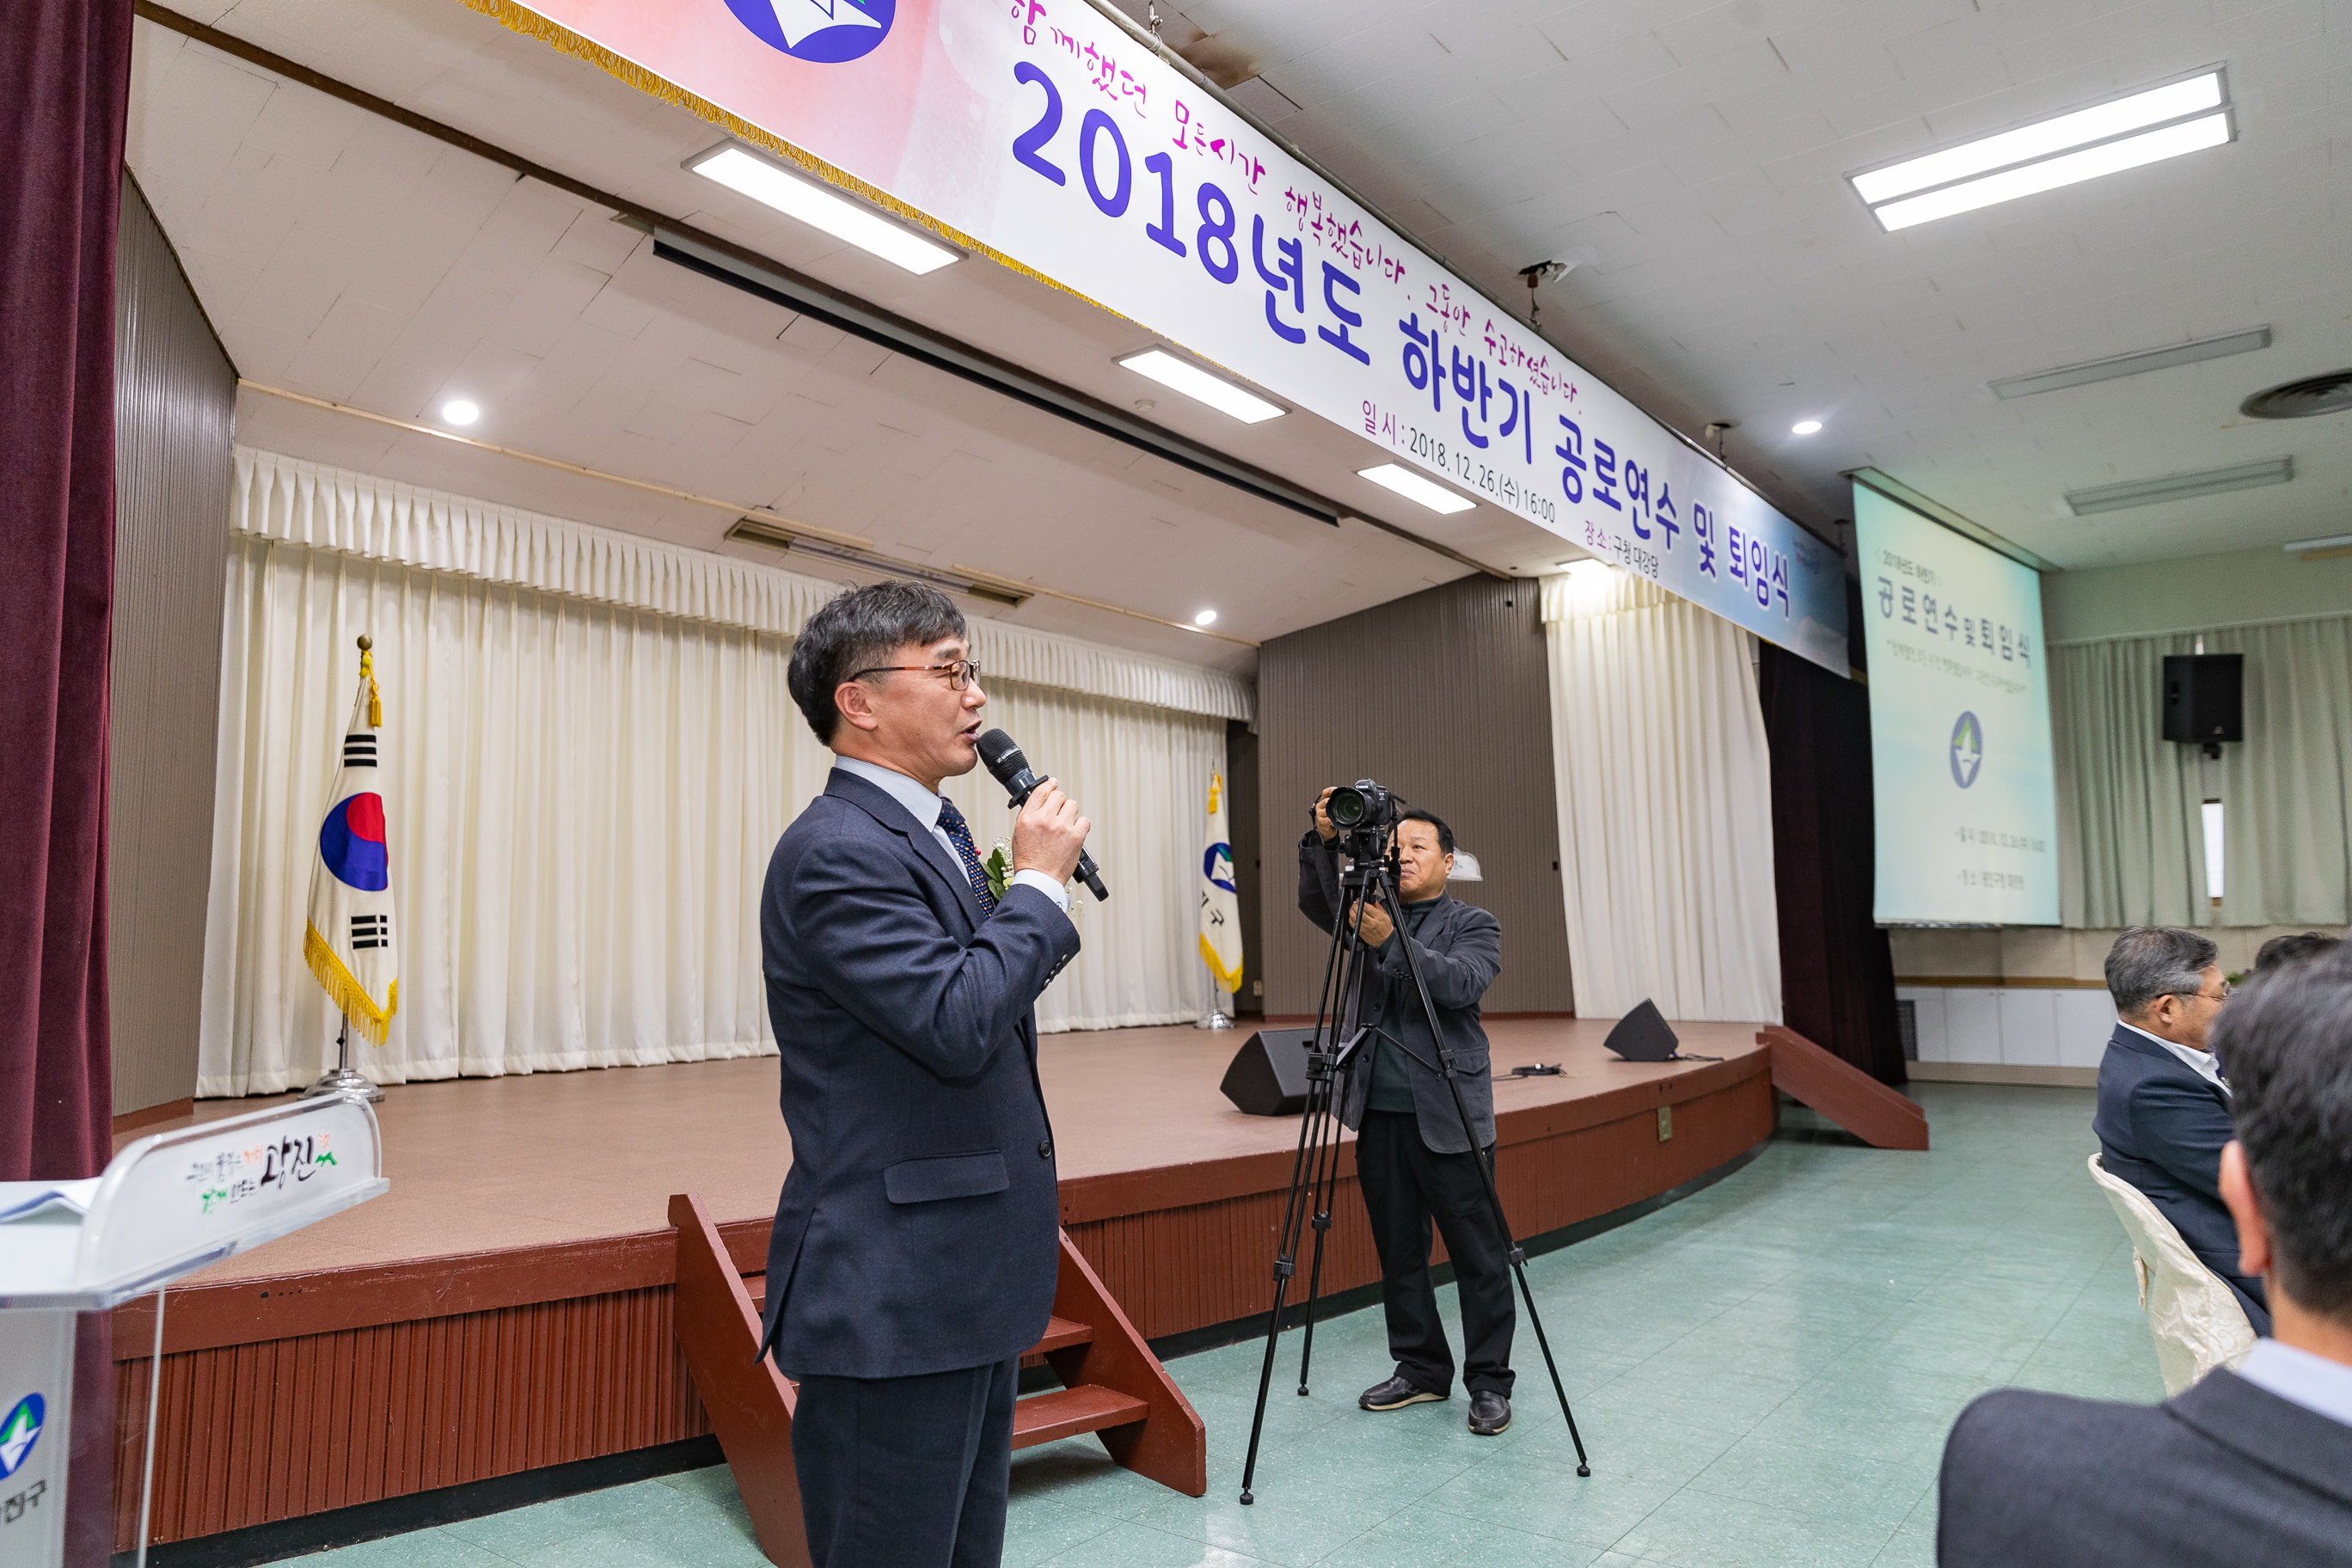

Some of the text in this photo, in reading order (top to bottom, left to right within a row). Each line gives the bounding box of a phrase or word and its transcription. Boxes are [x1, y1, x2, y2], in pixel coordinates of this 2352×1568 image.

[1425, 284, 1471, 336] 그동안
[1012, 61, 1789, 618] 2018년도 하반기 공로연수 및 퇴임식
[1524, 489, 1555, 524] 16:00
[1614, 536, 1631, 565] 구청
[260, 1135, 316, 1190] 광진
